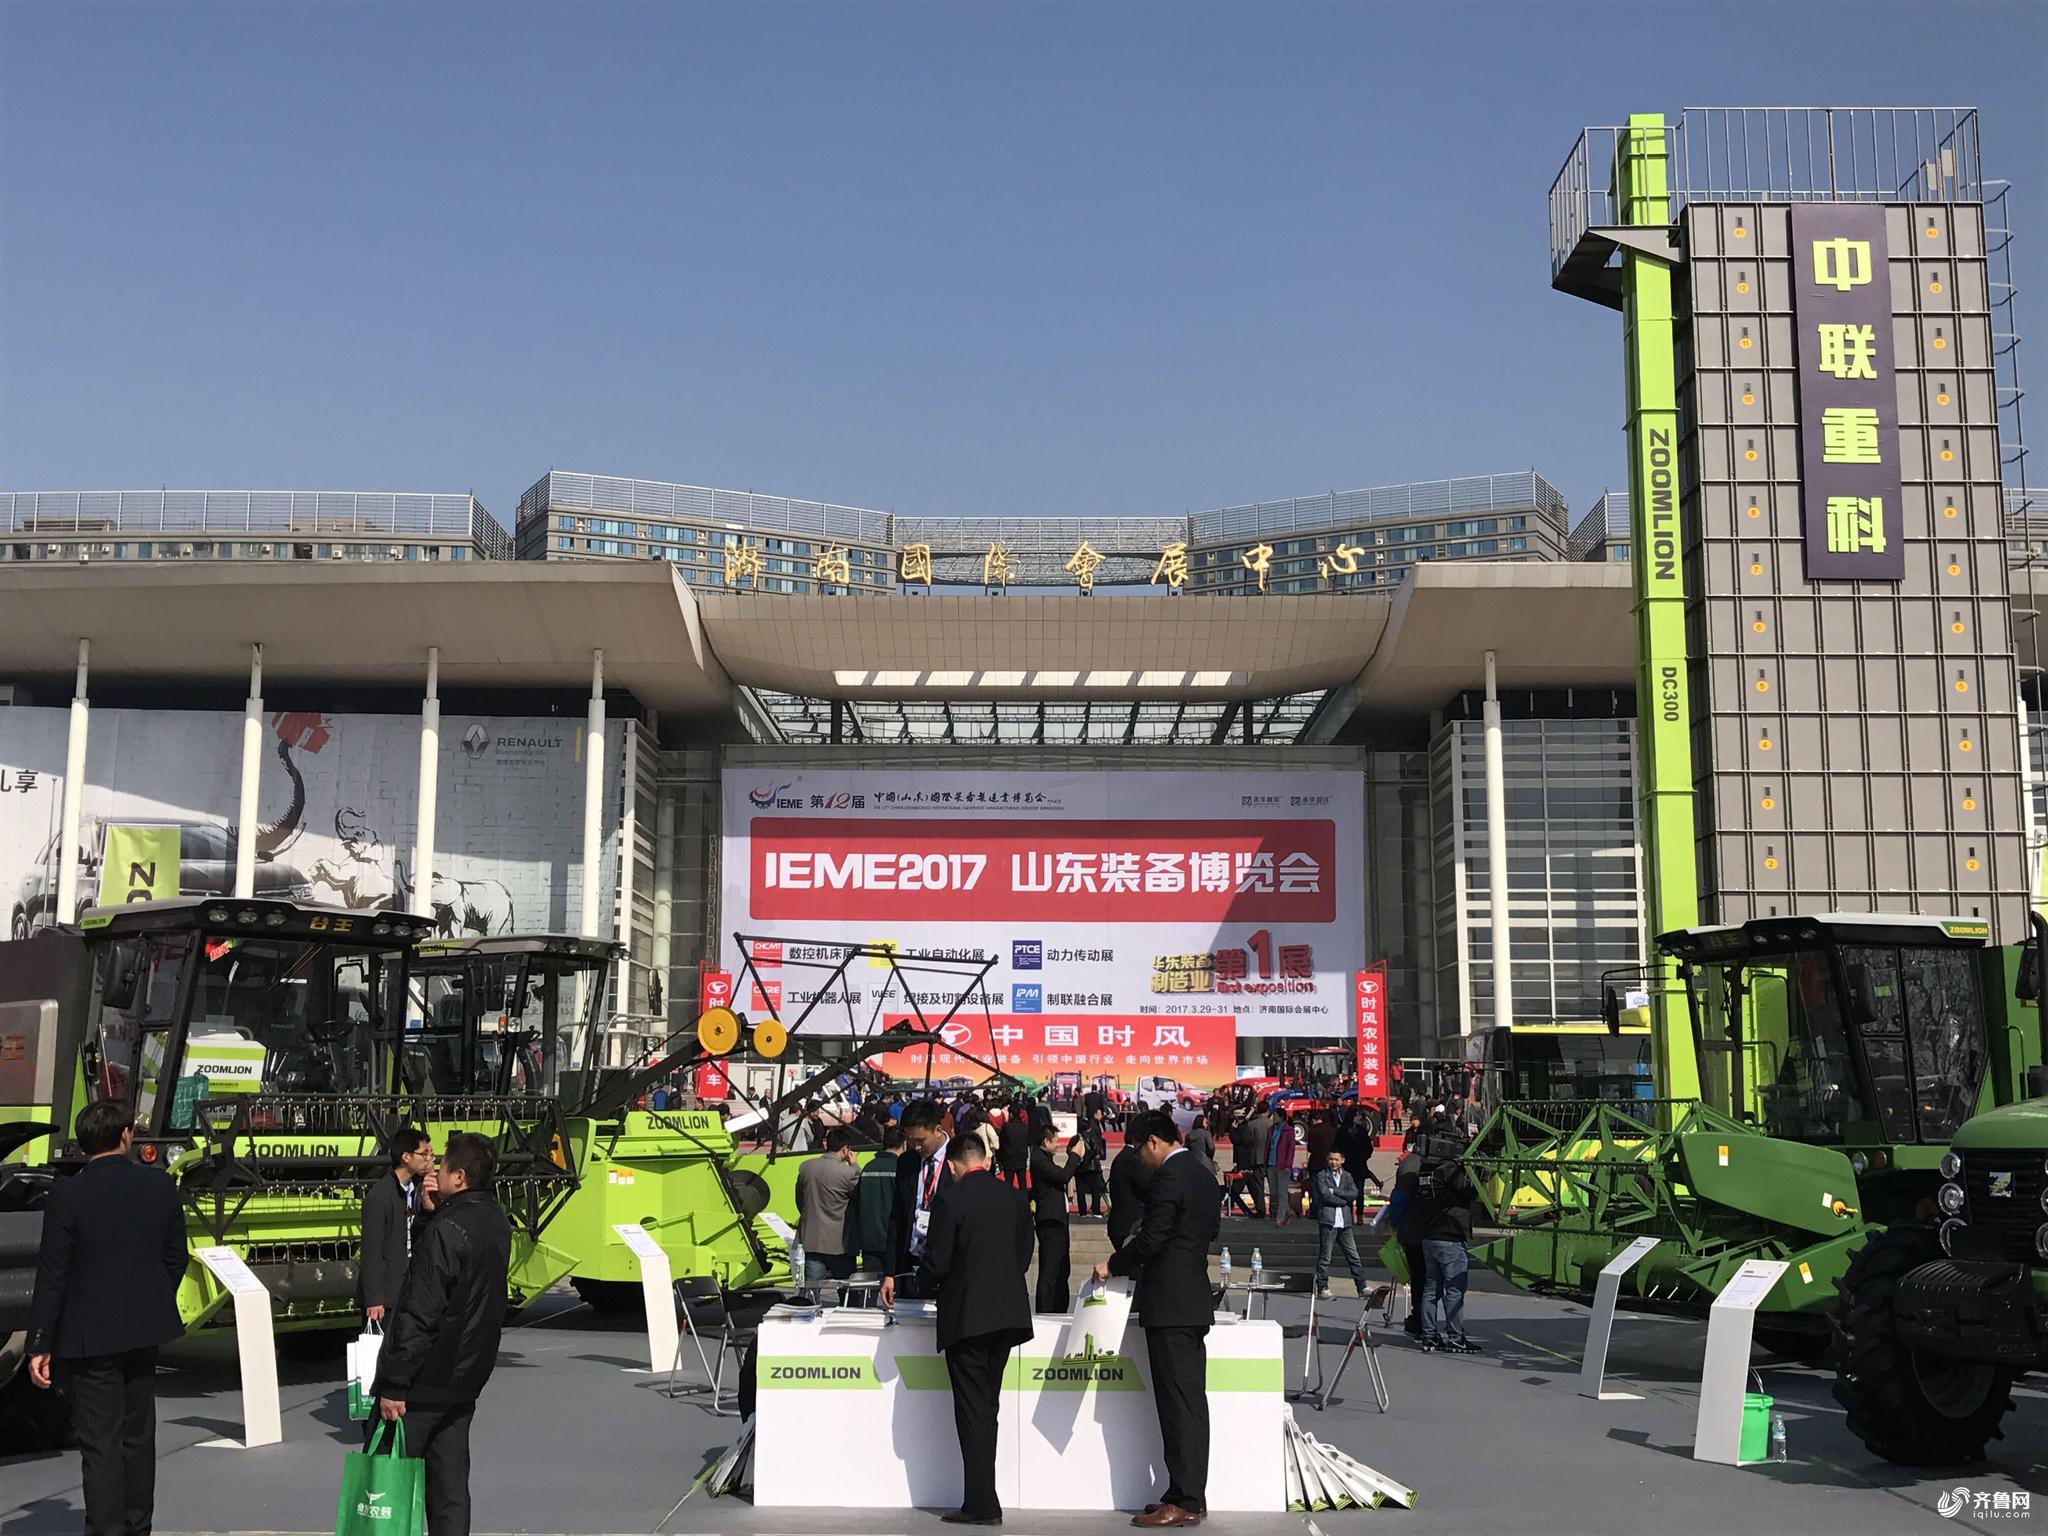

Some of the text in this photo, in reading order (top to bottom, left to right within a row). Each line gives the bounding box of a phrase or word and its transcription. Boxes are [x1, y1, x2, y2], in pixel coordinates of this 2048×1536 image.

[1812, 237, 1887, 553] 中联重科
[1650, 428, 1675, 580] ZOOMLION
[1662, 667, 1679, 722] DC300
[497, 737, 563, 748] RENAULT
[777, 799, 803, 809] IEME
[810, 792, 865, 809] 第12届
[765, 852, 1320, 893] IEME2017 山东装备博览会
[1950, 926, 1988, 934] ZOOMLION
[1014, 945, 1041, 954] PTCE
[1047, 948, 1114, 962] 动力传动展
[1216, 929, 1313, 980] 第1展
[1151, 970, 1211, 993] 制造业
[1244, 980, 1315, 995] exposition
[1016, 988, 1039, 998] IPM
[1047, 992, 1113, 1006] 制联融合展
[991, 1025, 1190, 1047] 中国时风
[1361, 997, 1379, 1086] 时风农业装备
[1032, 1054, 1114, 1065] 引领中国行业
[1125, 1054, 1209, 1065] 走向世界市场
[198, 1064, 252, 1075] ZOOMLION
[646, 1115, 709, 1130] ZOOMLION
[245, 1144, 339, 1158] ZOOMLION
[770, 1366, 861, 1379] ZOOMLION
[1032, 1367, 1124, 1381] ZOOMLION
